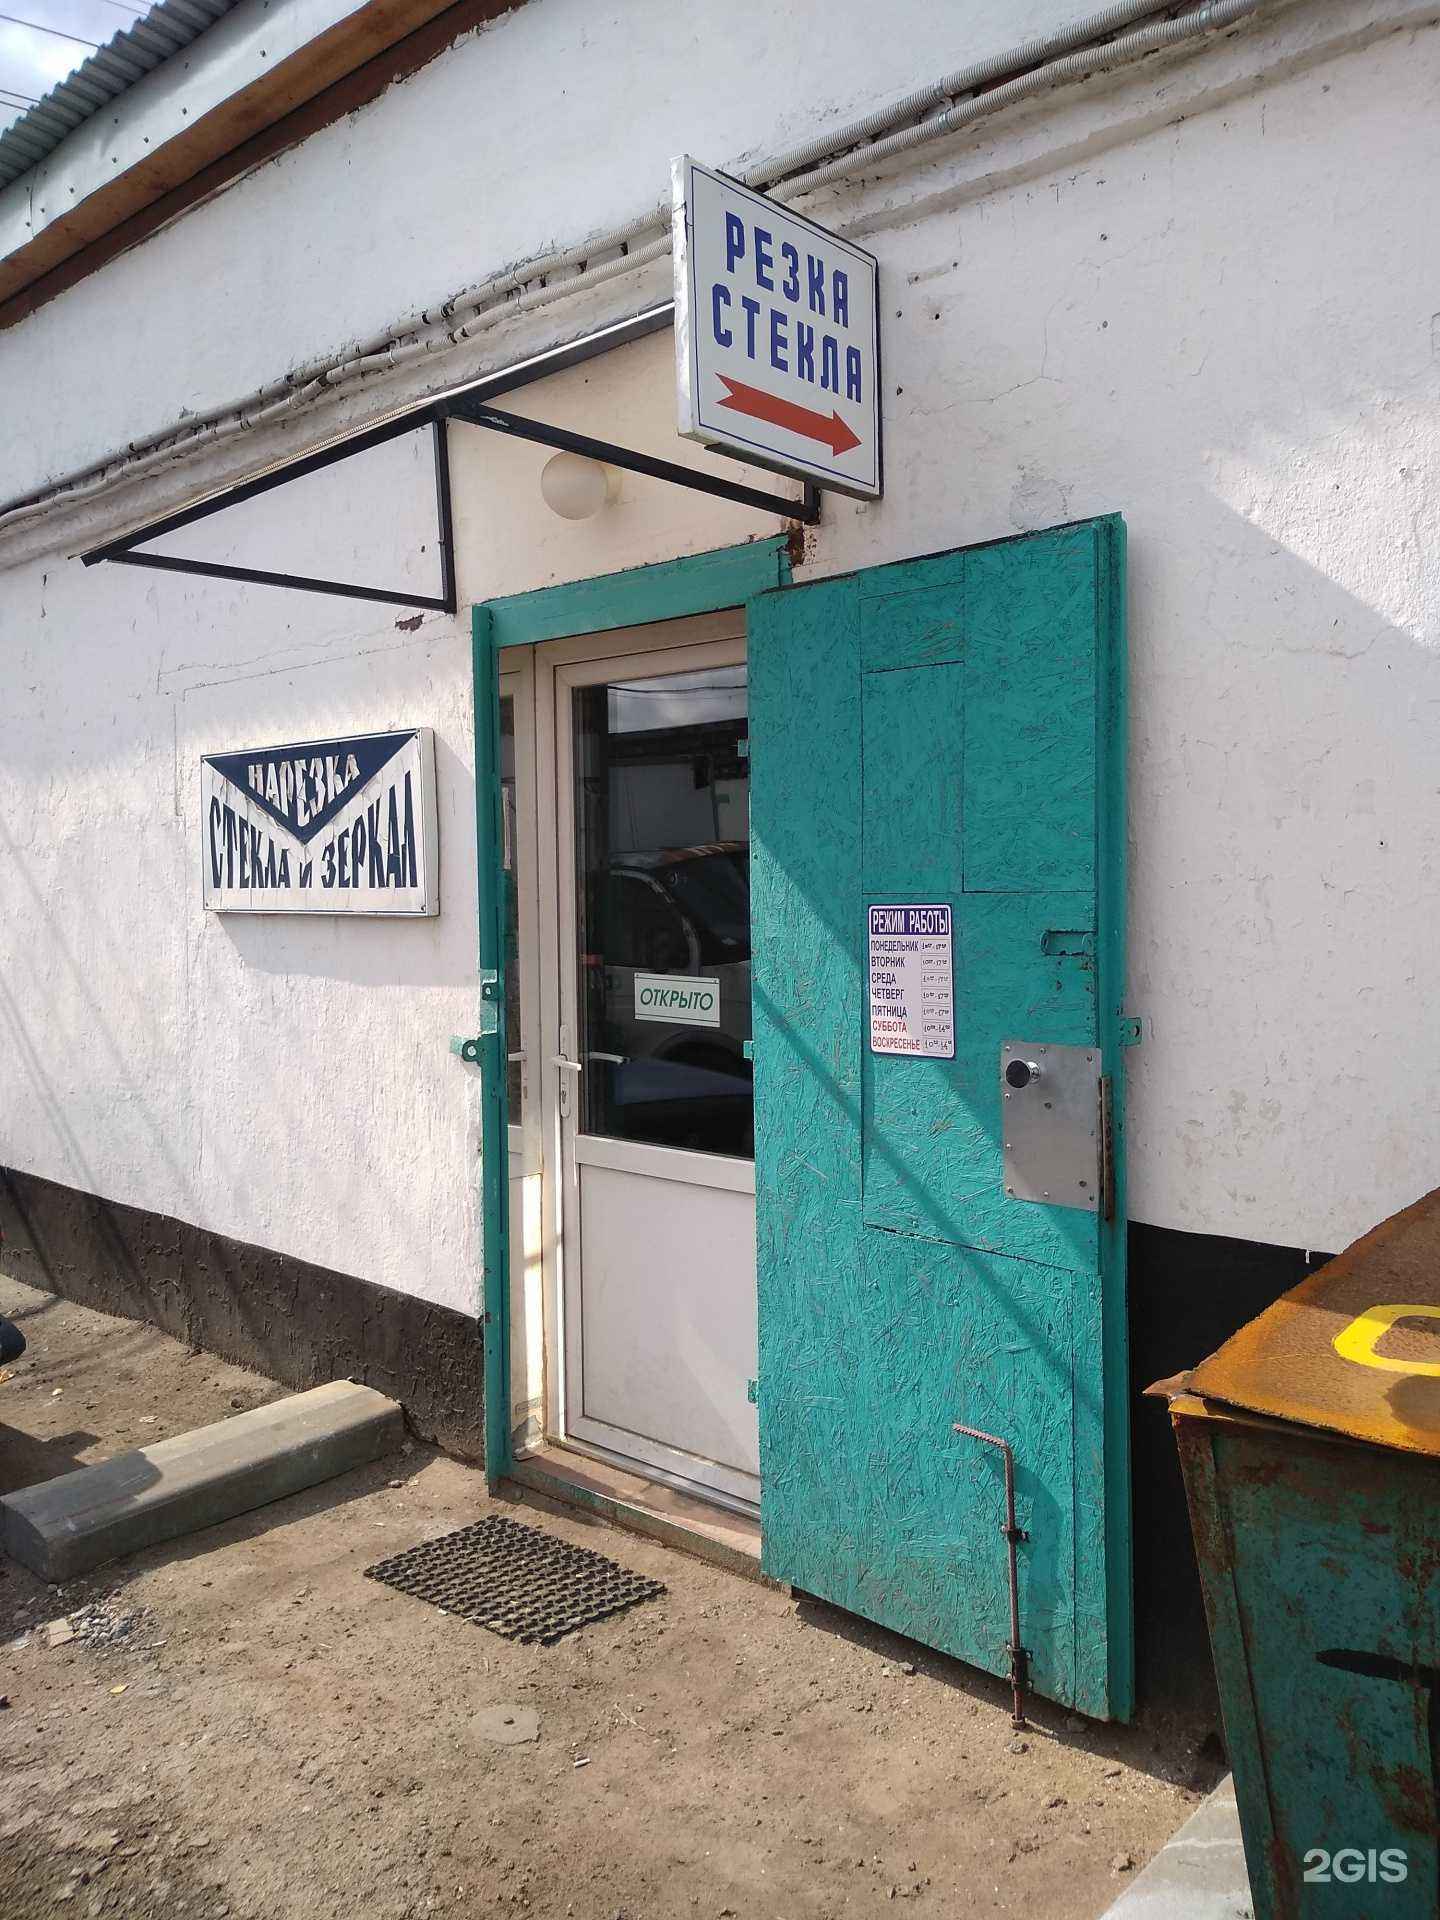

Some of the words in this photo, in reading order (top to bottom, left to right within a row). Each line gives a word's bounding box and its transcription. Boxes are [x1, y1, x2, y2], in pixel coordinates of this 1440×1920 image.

[725, 209, 849, 329] РЕЗКА
[711, 282, 862, 404] СТЕКЛА
[248, 753, 361, 827] НАРЕЗКА
[209, 795, 291, 889] СТЕКЛА
[321, 770, 418, 889] ЗЕРКАЛ
[872, 910, 905, 933] РЕЖИМ
[909, 910, 948, 934] РАБОТЫ
[871, 940, 919, 953] ПОНЕДЕЛЬНИК
[871, 956, 905, 968] ВТОРНИК
[871, 972, 897, 986] СРЕДА
[640, 988, 714, 1011] ОТКРЫТО
[871, 988, 905, 1000] ЧЕТВЕРГ
[871, 1005, 908, 1020] ПЯТНИЦА
[872, 1020, 908, 1033] СУББОТА
[872, 1036, 920, 1051] ВОСКРЕСЕНЬЕ
